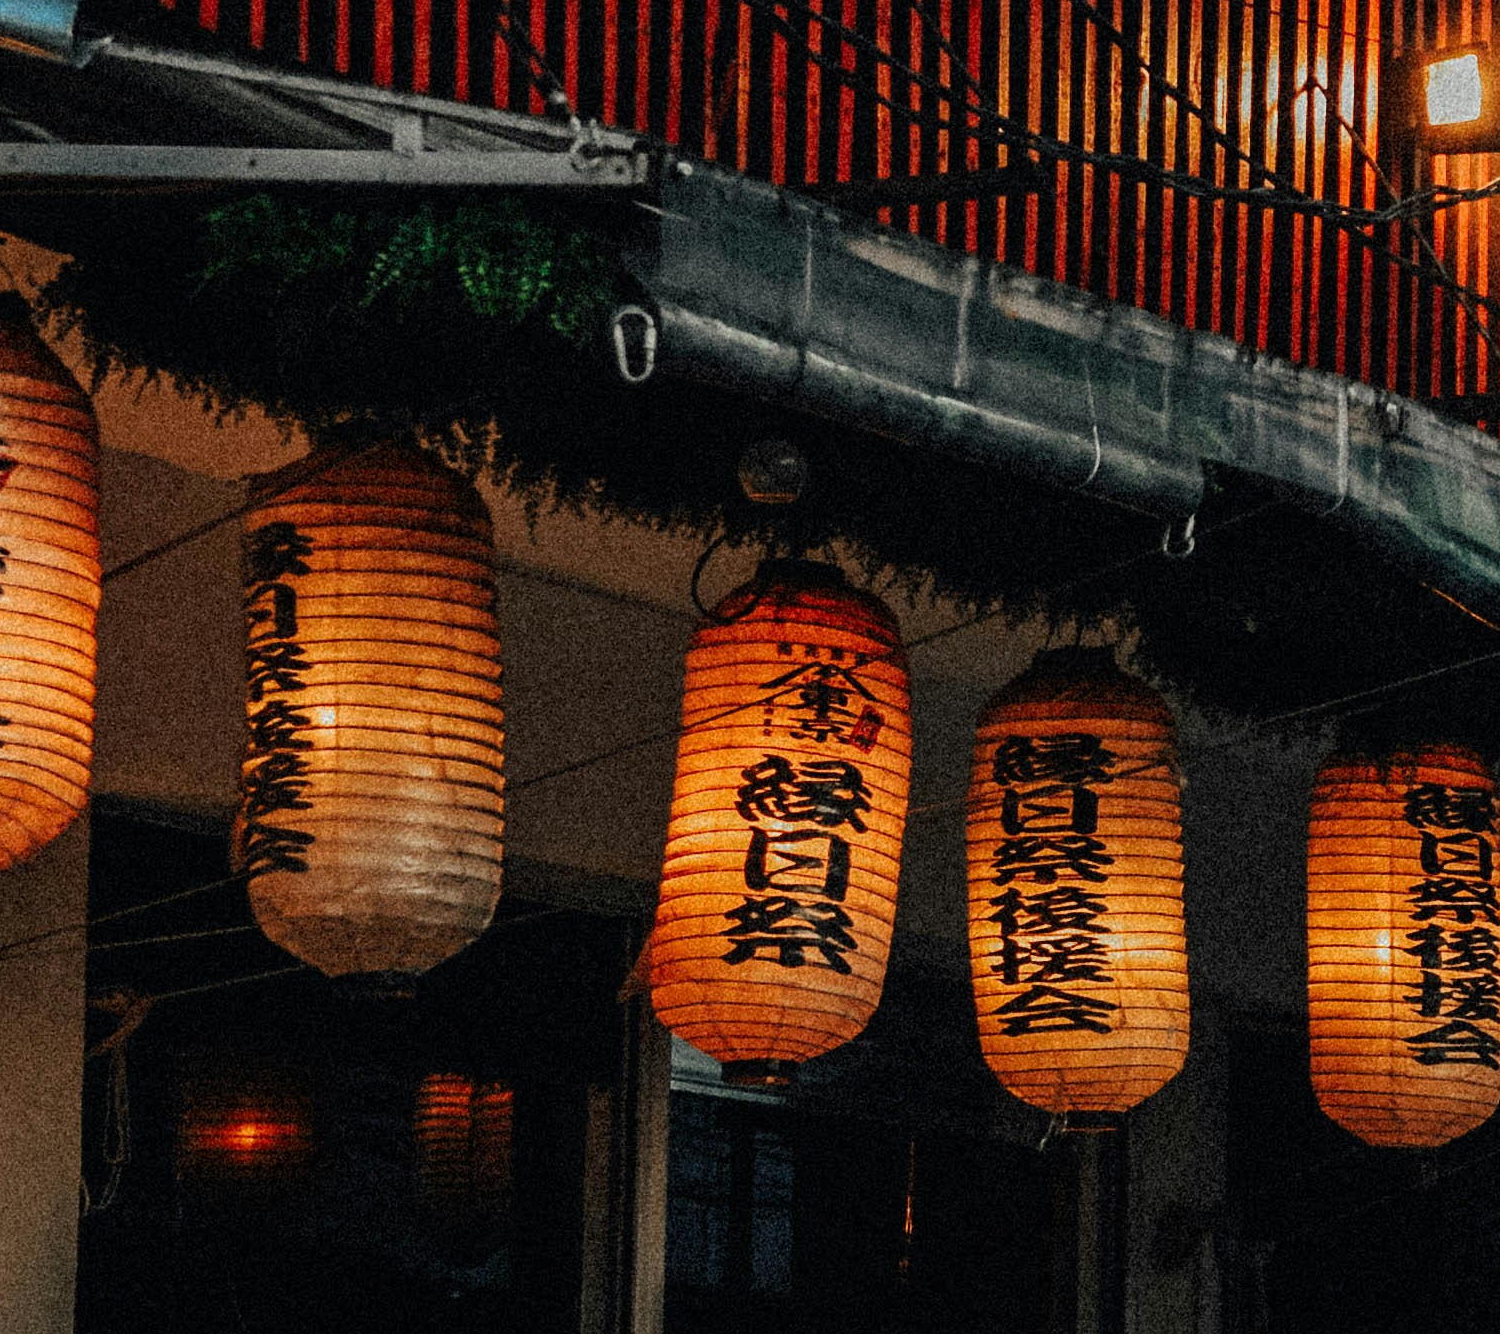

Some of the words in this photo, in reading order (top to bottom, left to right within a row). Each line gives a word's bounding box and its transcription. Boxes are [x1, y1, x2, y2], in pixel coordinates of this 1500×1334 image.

[721, 753, 873, 975] 縁日祭
[989, 732, 1118, 1037] 縁日祭後援会
